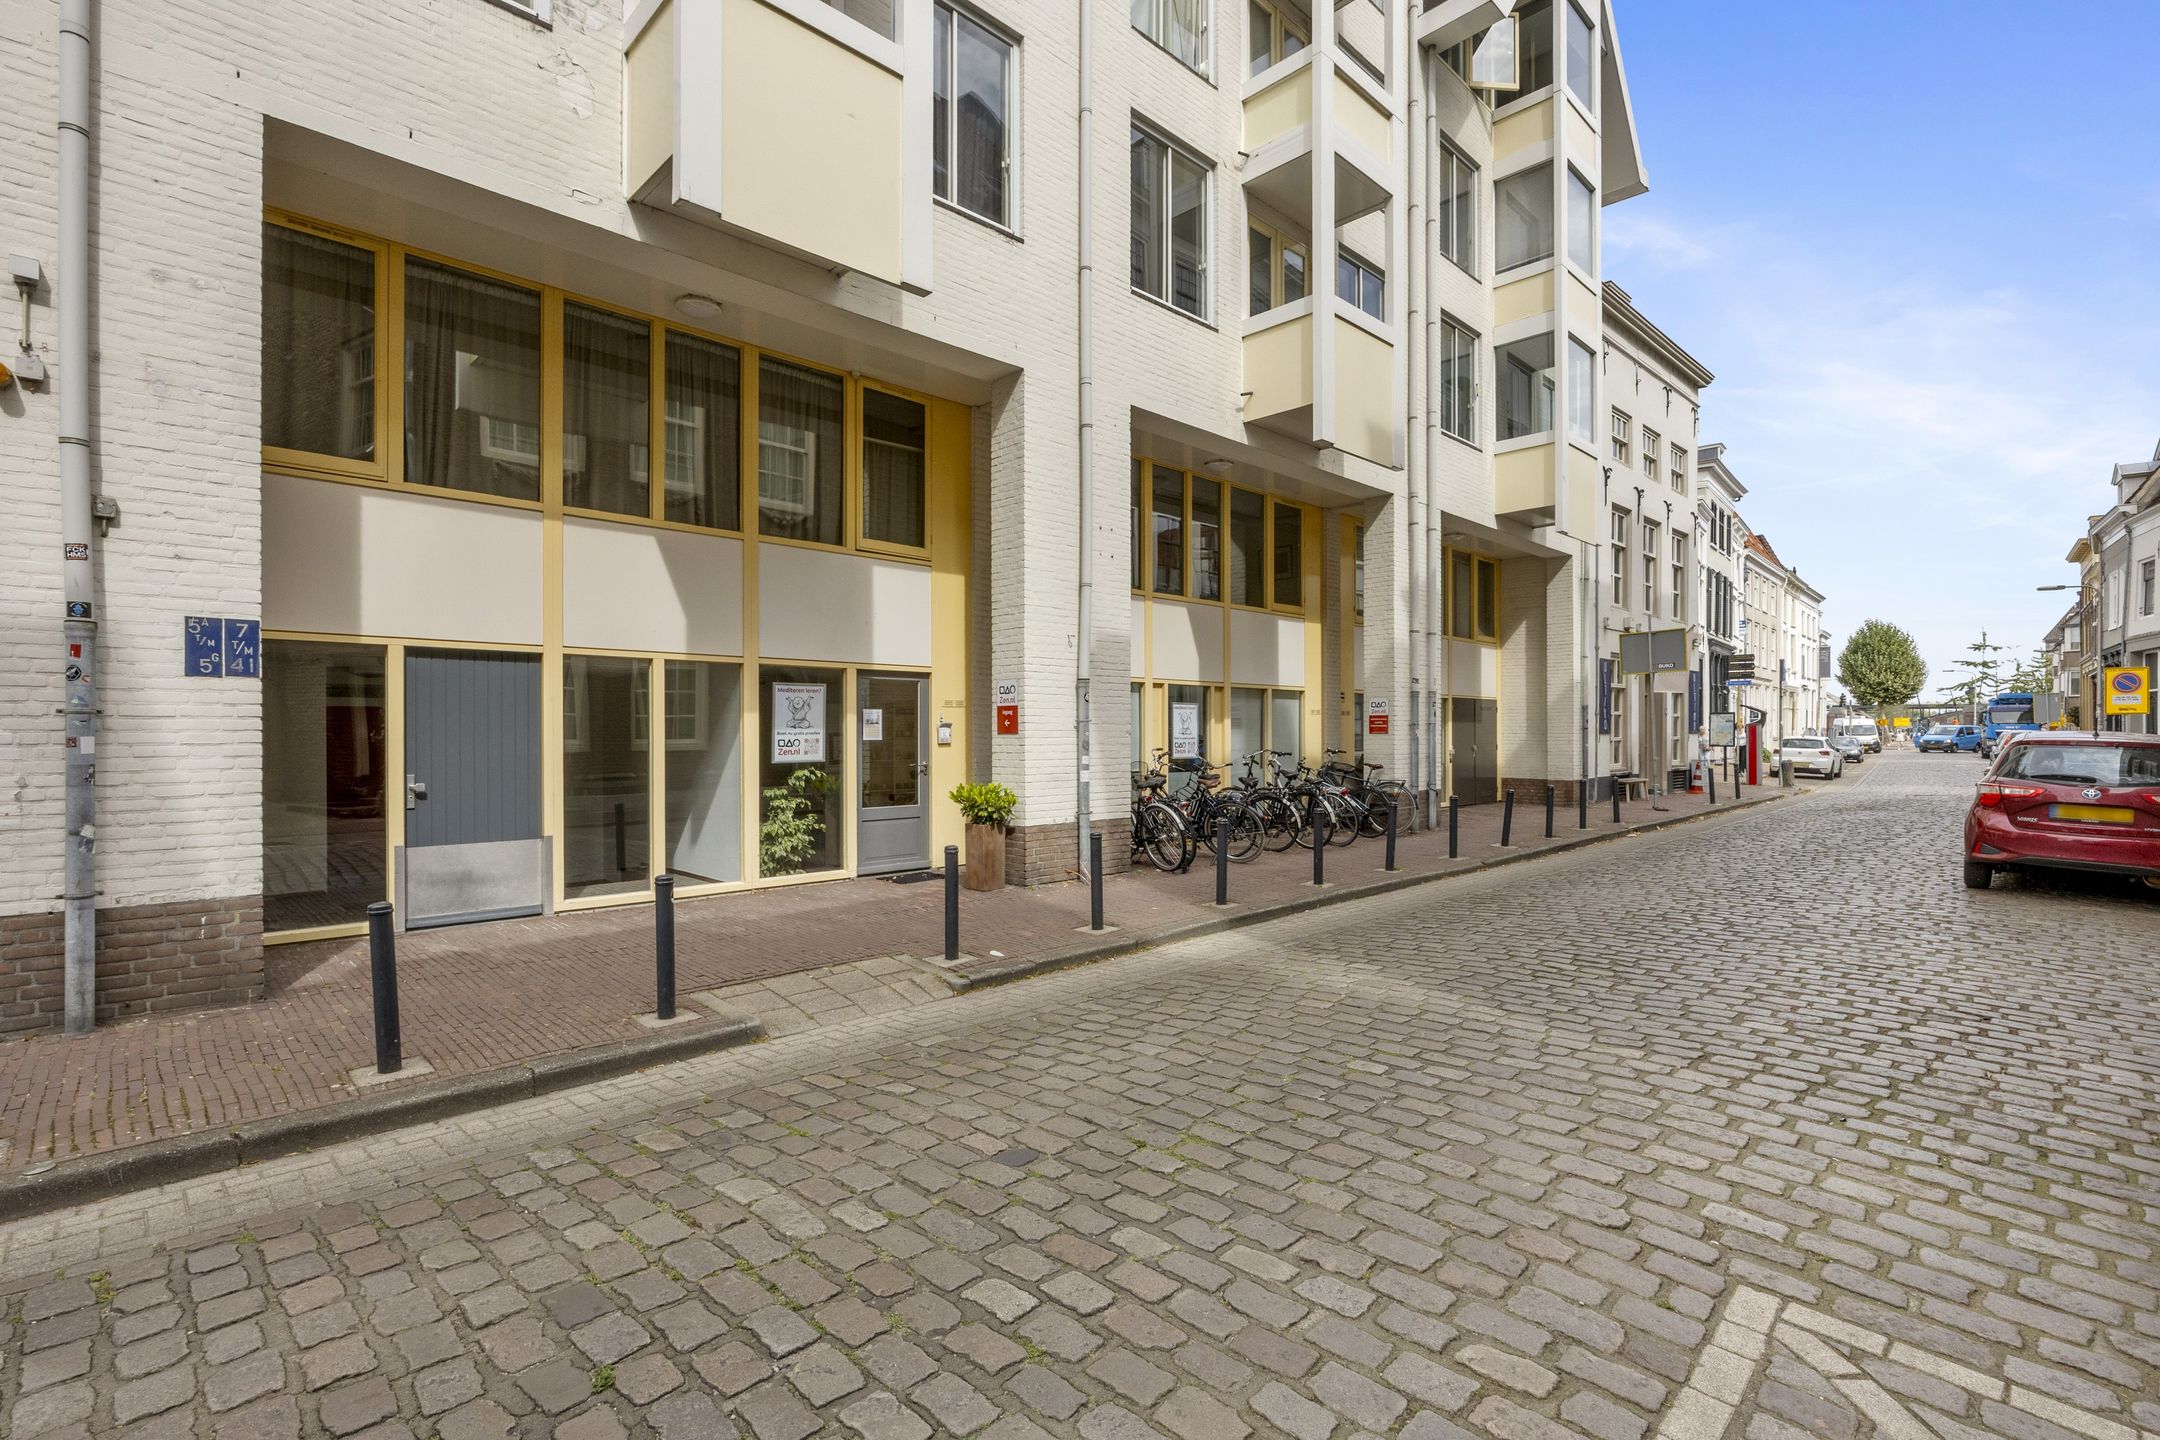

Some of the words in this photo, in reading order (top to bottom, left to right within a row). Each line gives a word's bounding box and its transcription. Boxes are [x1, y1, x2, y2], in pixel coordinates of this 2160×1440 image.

[236, 623, 249, 638] 7
[231, 640, 254, 655] T/M
[230, 657, 254, 673] 41
[999, 696, 1016, 704] Zen.nl
[777, 748, 801, 756] Zen.nl
